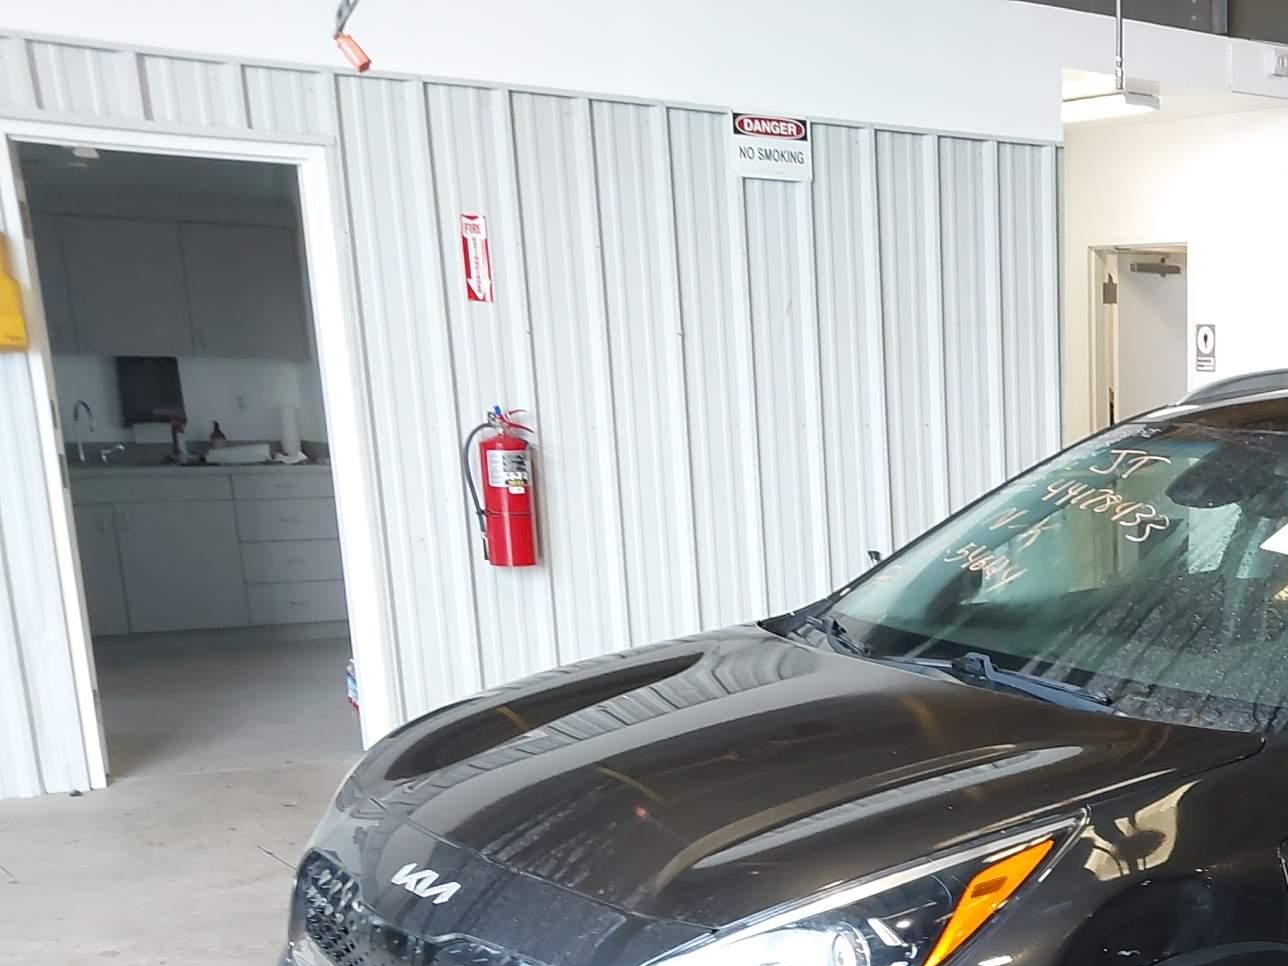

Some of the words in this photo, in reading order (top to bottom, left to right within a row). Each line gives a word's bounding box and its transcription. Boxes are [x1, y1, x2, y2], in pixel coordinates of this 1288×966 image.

[742, 118, 798, 137] DANGER
[739, 145, 755, 160] NO
[757, 147, 805, 165] SMOKING
[1089, 449, 1172, 479] JT
[1042, 478, 1170, 543] 44178433
[391, 863, 461, 904] KIA
